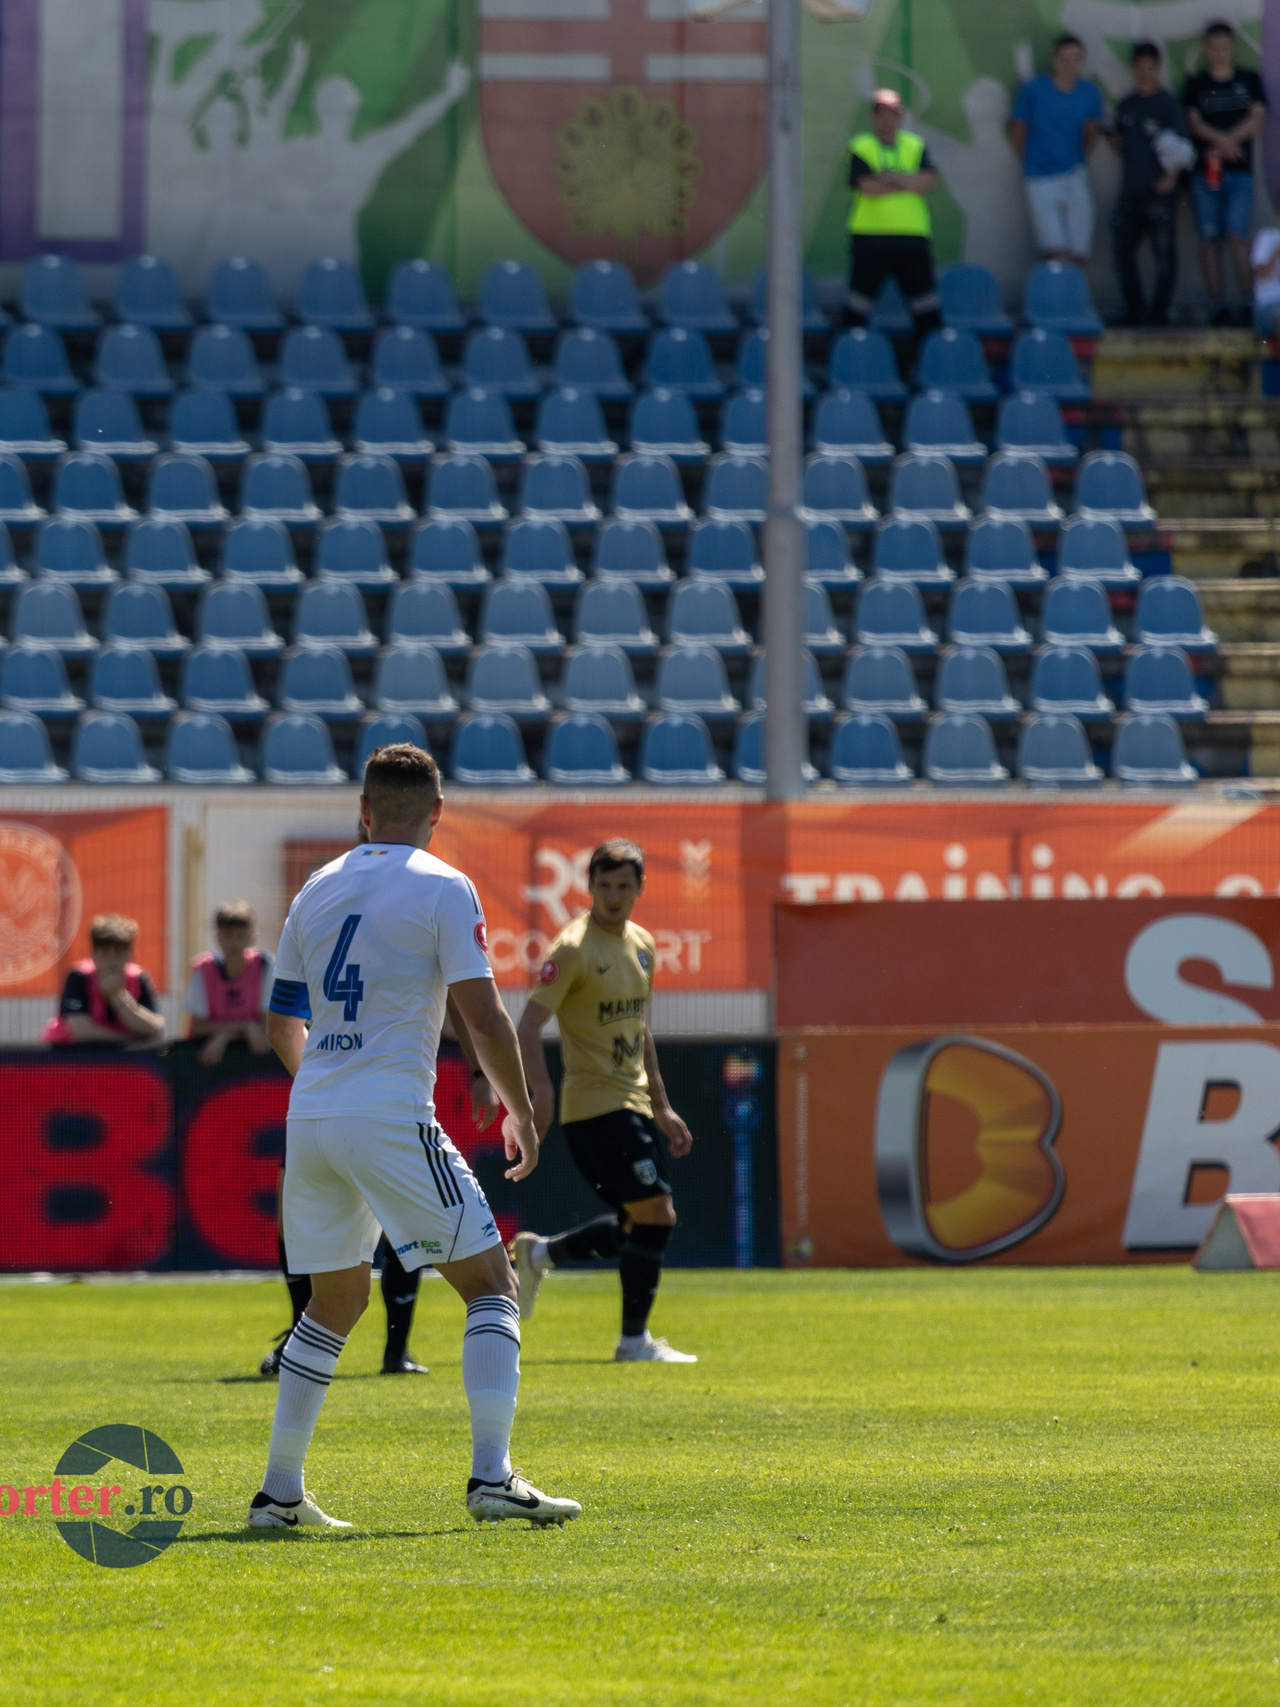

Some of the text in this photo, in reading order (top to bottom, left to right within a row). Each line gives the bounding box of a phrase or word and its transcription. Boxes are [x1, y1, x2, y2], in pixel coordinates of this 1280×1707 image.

[323, 914, 364, 1022] 4
[317, 1032, 363, 1051] MIRON
[420, 1240, 441, 1249] Eco
[426, 1247, 443, 1255] Plus
